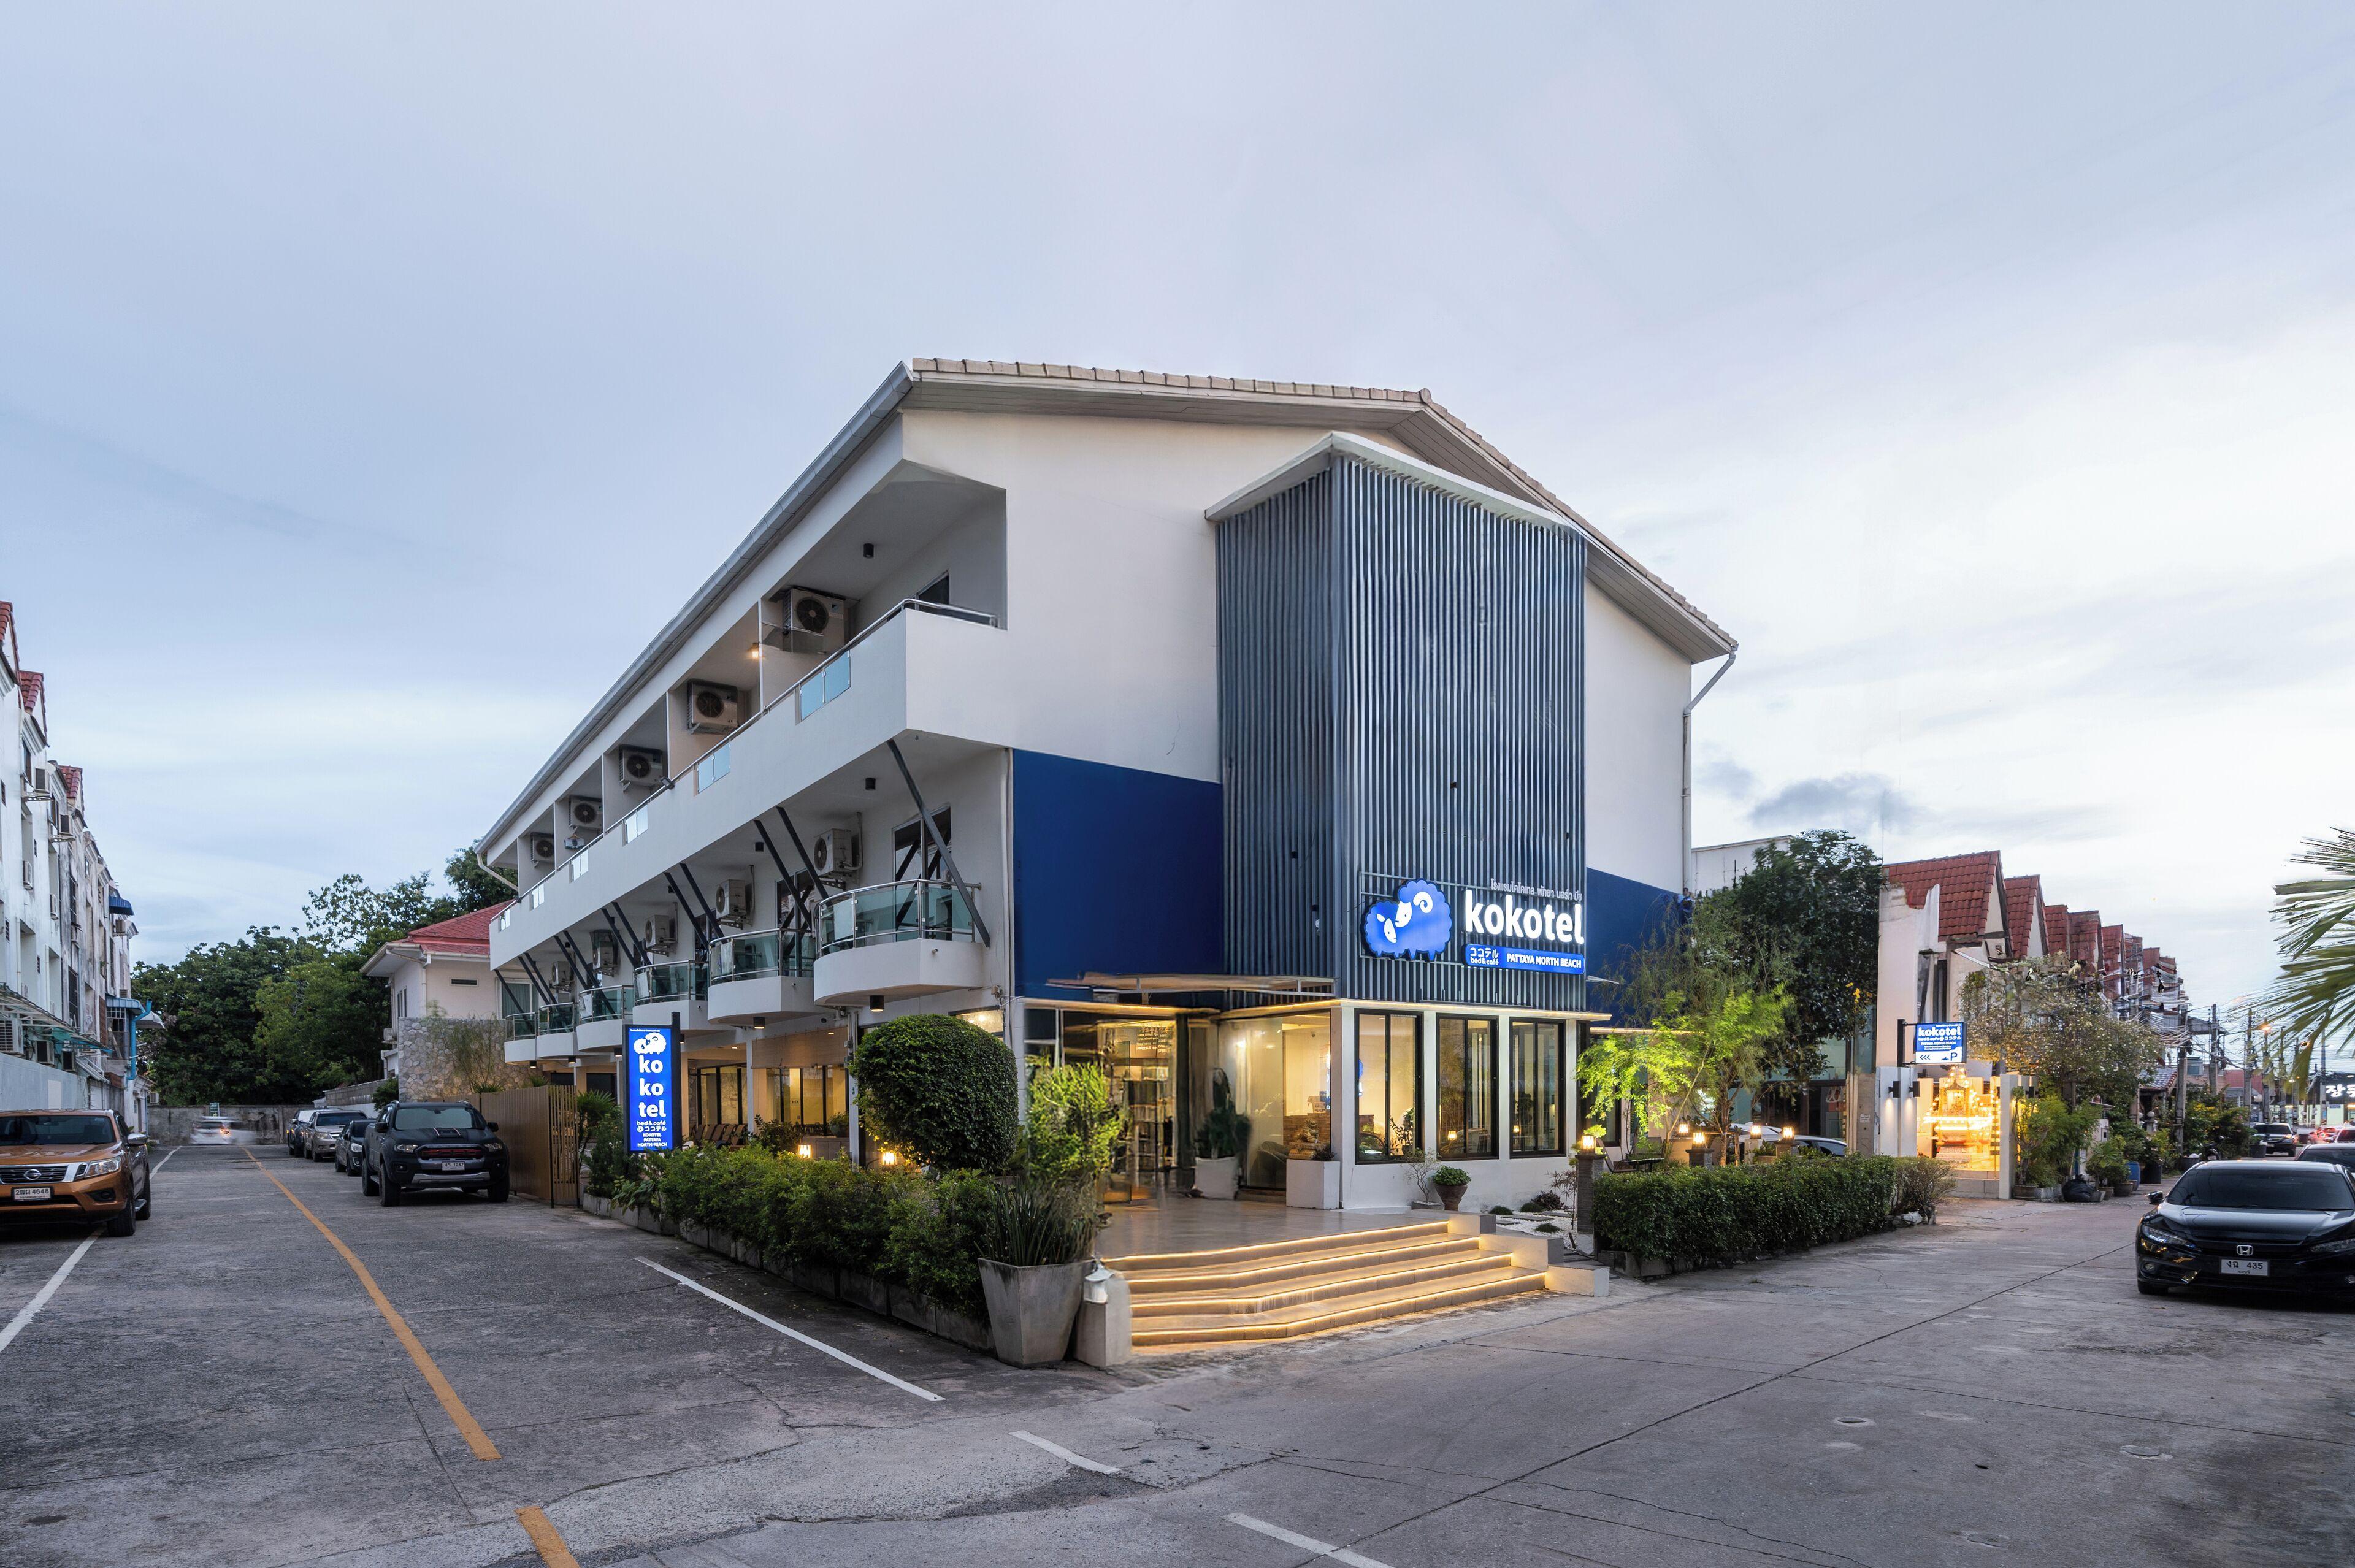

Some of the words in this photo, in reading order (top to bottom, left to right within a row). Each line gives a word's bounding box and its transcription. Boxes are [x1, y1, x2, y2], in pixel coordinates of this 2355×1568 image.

[1490, 878, 1534, 895] โรงแรมโคโคเทล
[1537, 885, 1555, 898] พัทยา
[1465, 889, 1585, 944] kokotel
[1470, 947, 1499, 958] ココテル
[1506, 953, 1535, 964] PATTAYA
[1536, 956, 1560, 966] NORTH
[1560, 958, 1582, 968] BEACH
[1918, 1025, 1962, 1036] kokotel
[639, 1055, 664, 1073] ko
[1950, 1052, 1958, 1061] P
[639, 1077, 664, 1096] ko
[638, 1099, 667, 1117] tel
